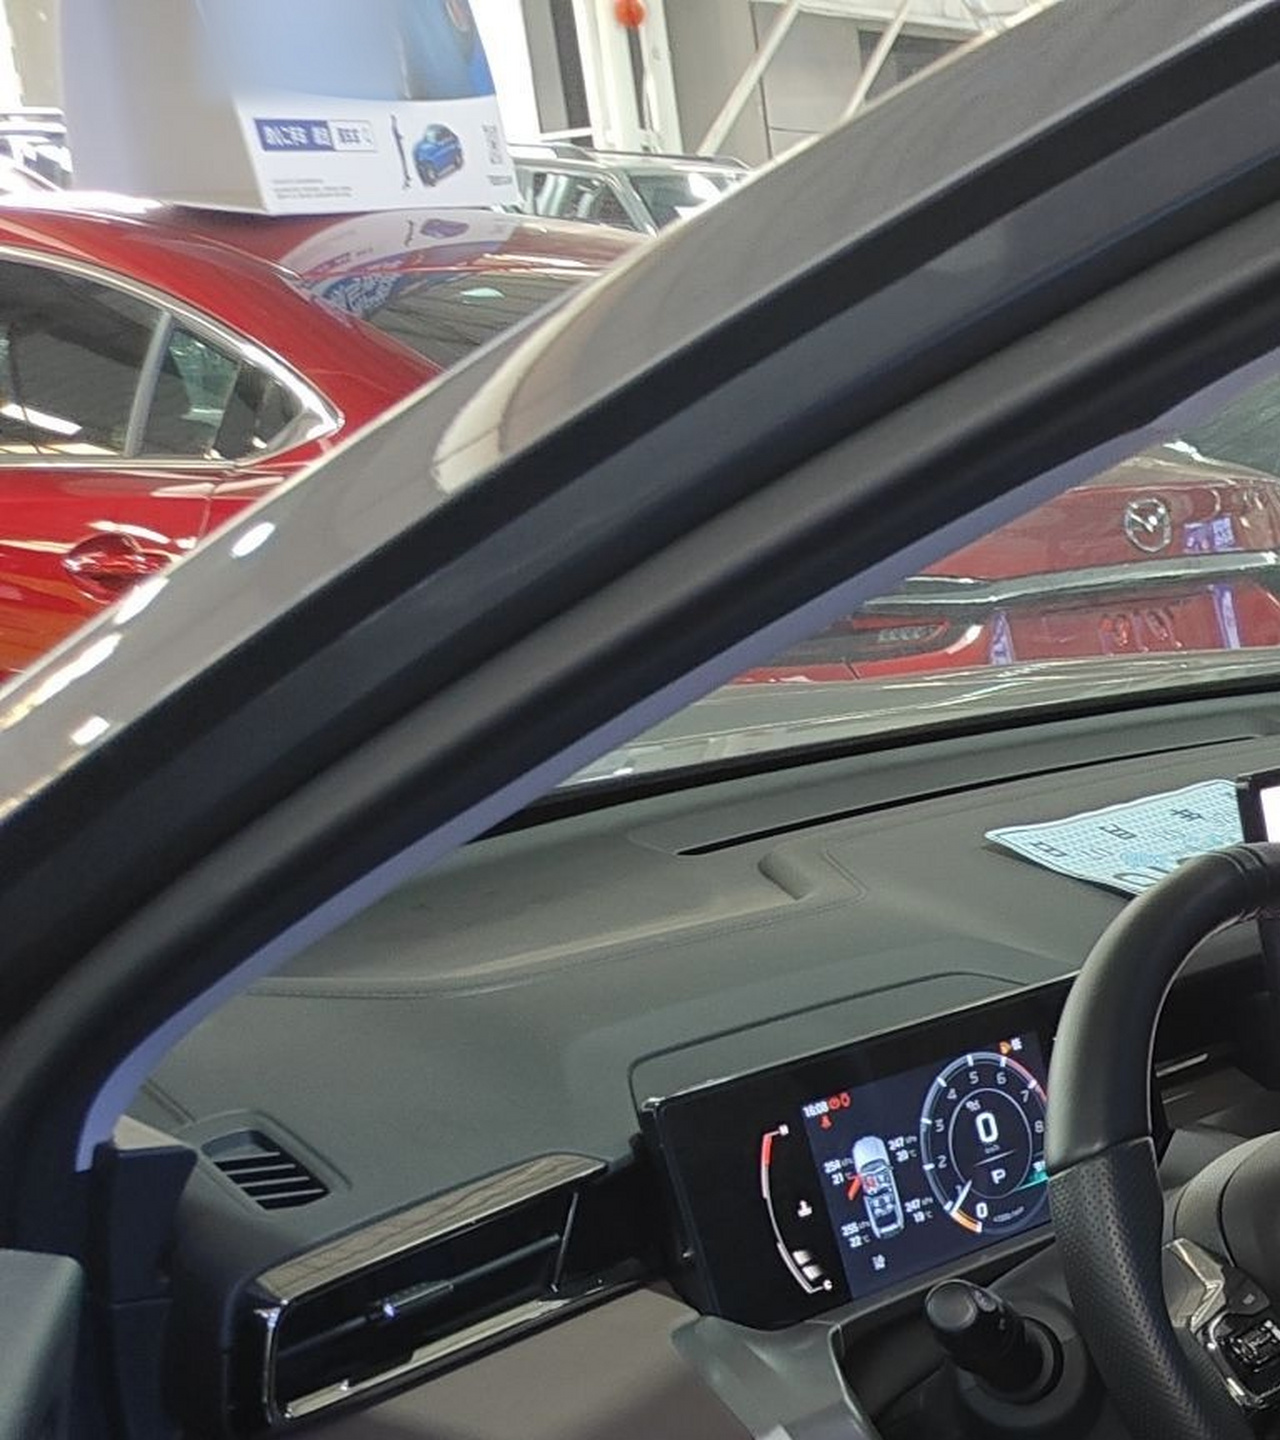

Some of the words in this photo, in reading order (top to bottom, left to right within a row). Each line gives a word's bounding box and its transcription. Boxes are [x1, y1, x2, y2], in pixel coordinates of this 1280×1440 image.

[969, 1071, 979, 1085] 5
[996, 1072, 1007, 1085] 6
[946, 1088, 957, 1100] 4
[1021, 1089, 1030, 1102] 7
[935, 1119, 945, 1132] 3
[975, 1111, 999, 1142] 0
[1034, 1120, 1044, 1133] 8
[937, 1155, 947, 1169] 2
[991, 1168, 1006, 1184] P
[976, 1202, 988, 1219] 0
